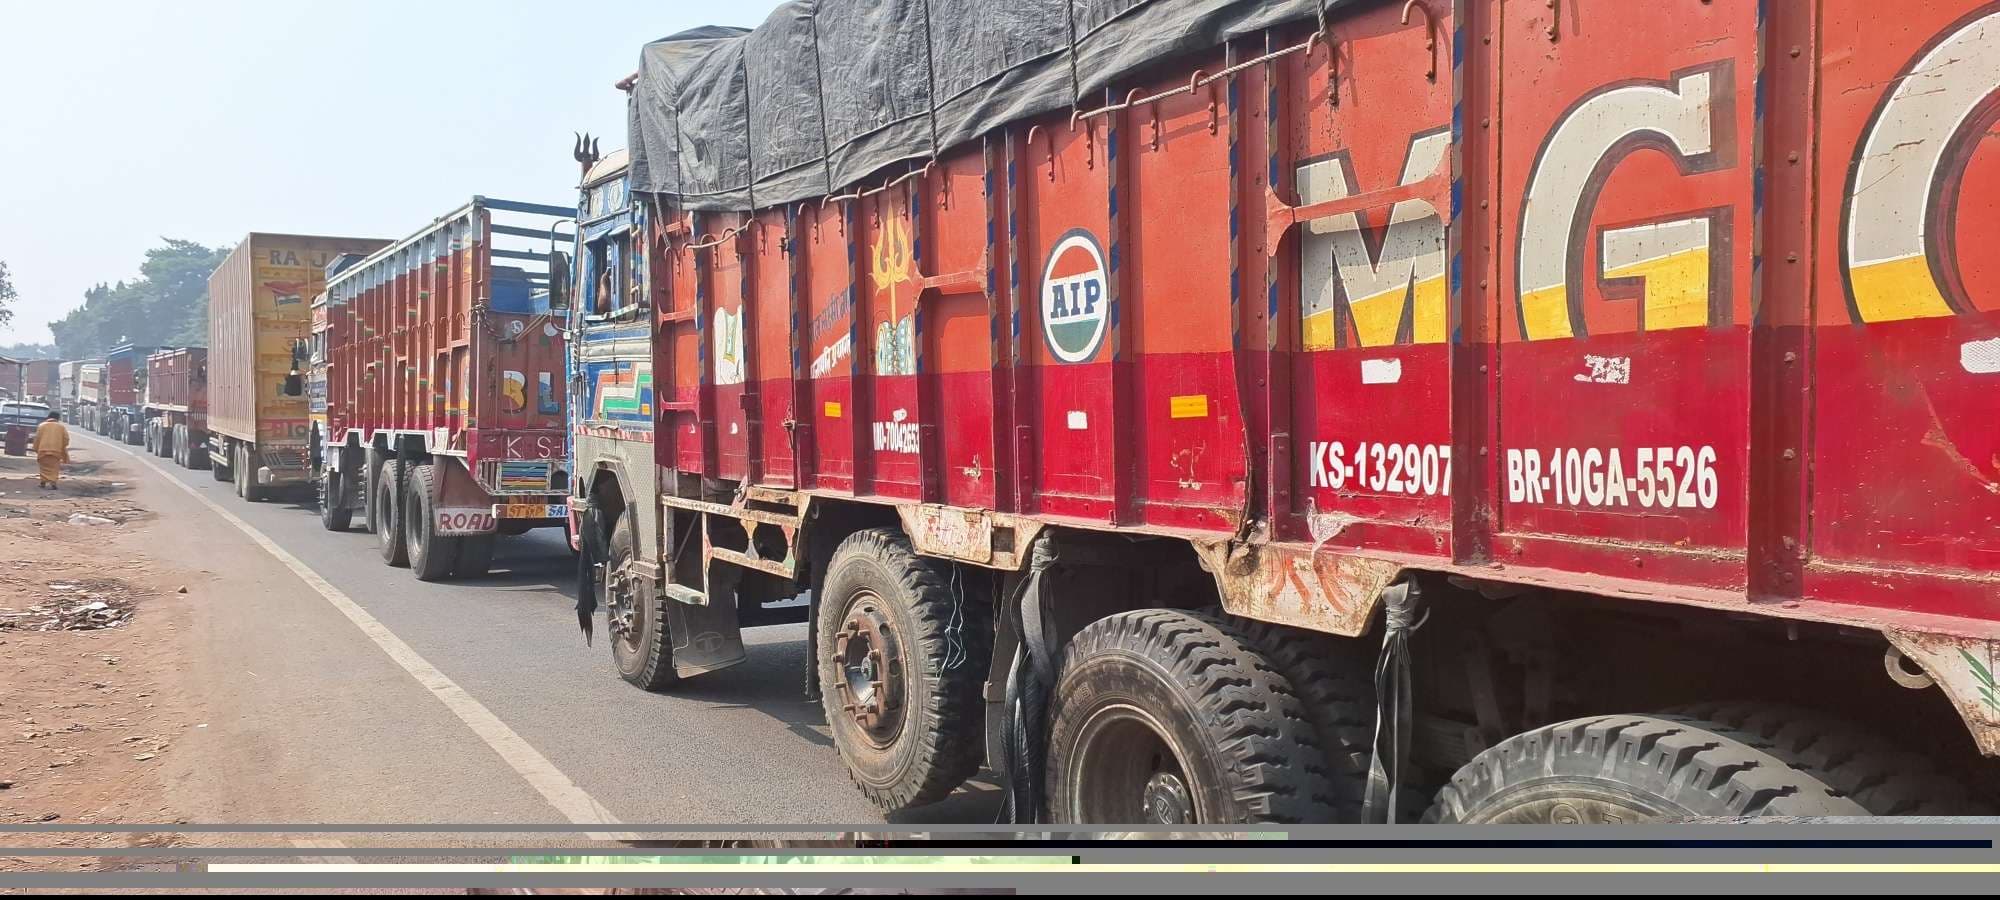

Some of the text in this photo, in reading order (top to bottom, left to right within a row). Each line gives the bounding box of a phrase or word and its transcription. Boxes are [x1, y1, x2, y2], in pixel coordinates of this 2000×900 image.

[1050, 278, 1101, 320] AIP
[1310, 441, 1453, 496] KS-132907
[1507, 445, 1718, 509] BR-10GA-5526
[439, 512, 496, 531] ROAD
